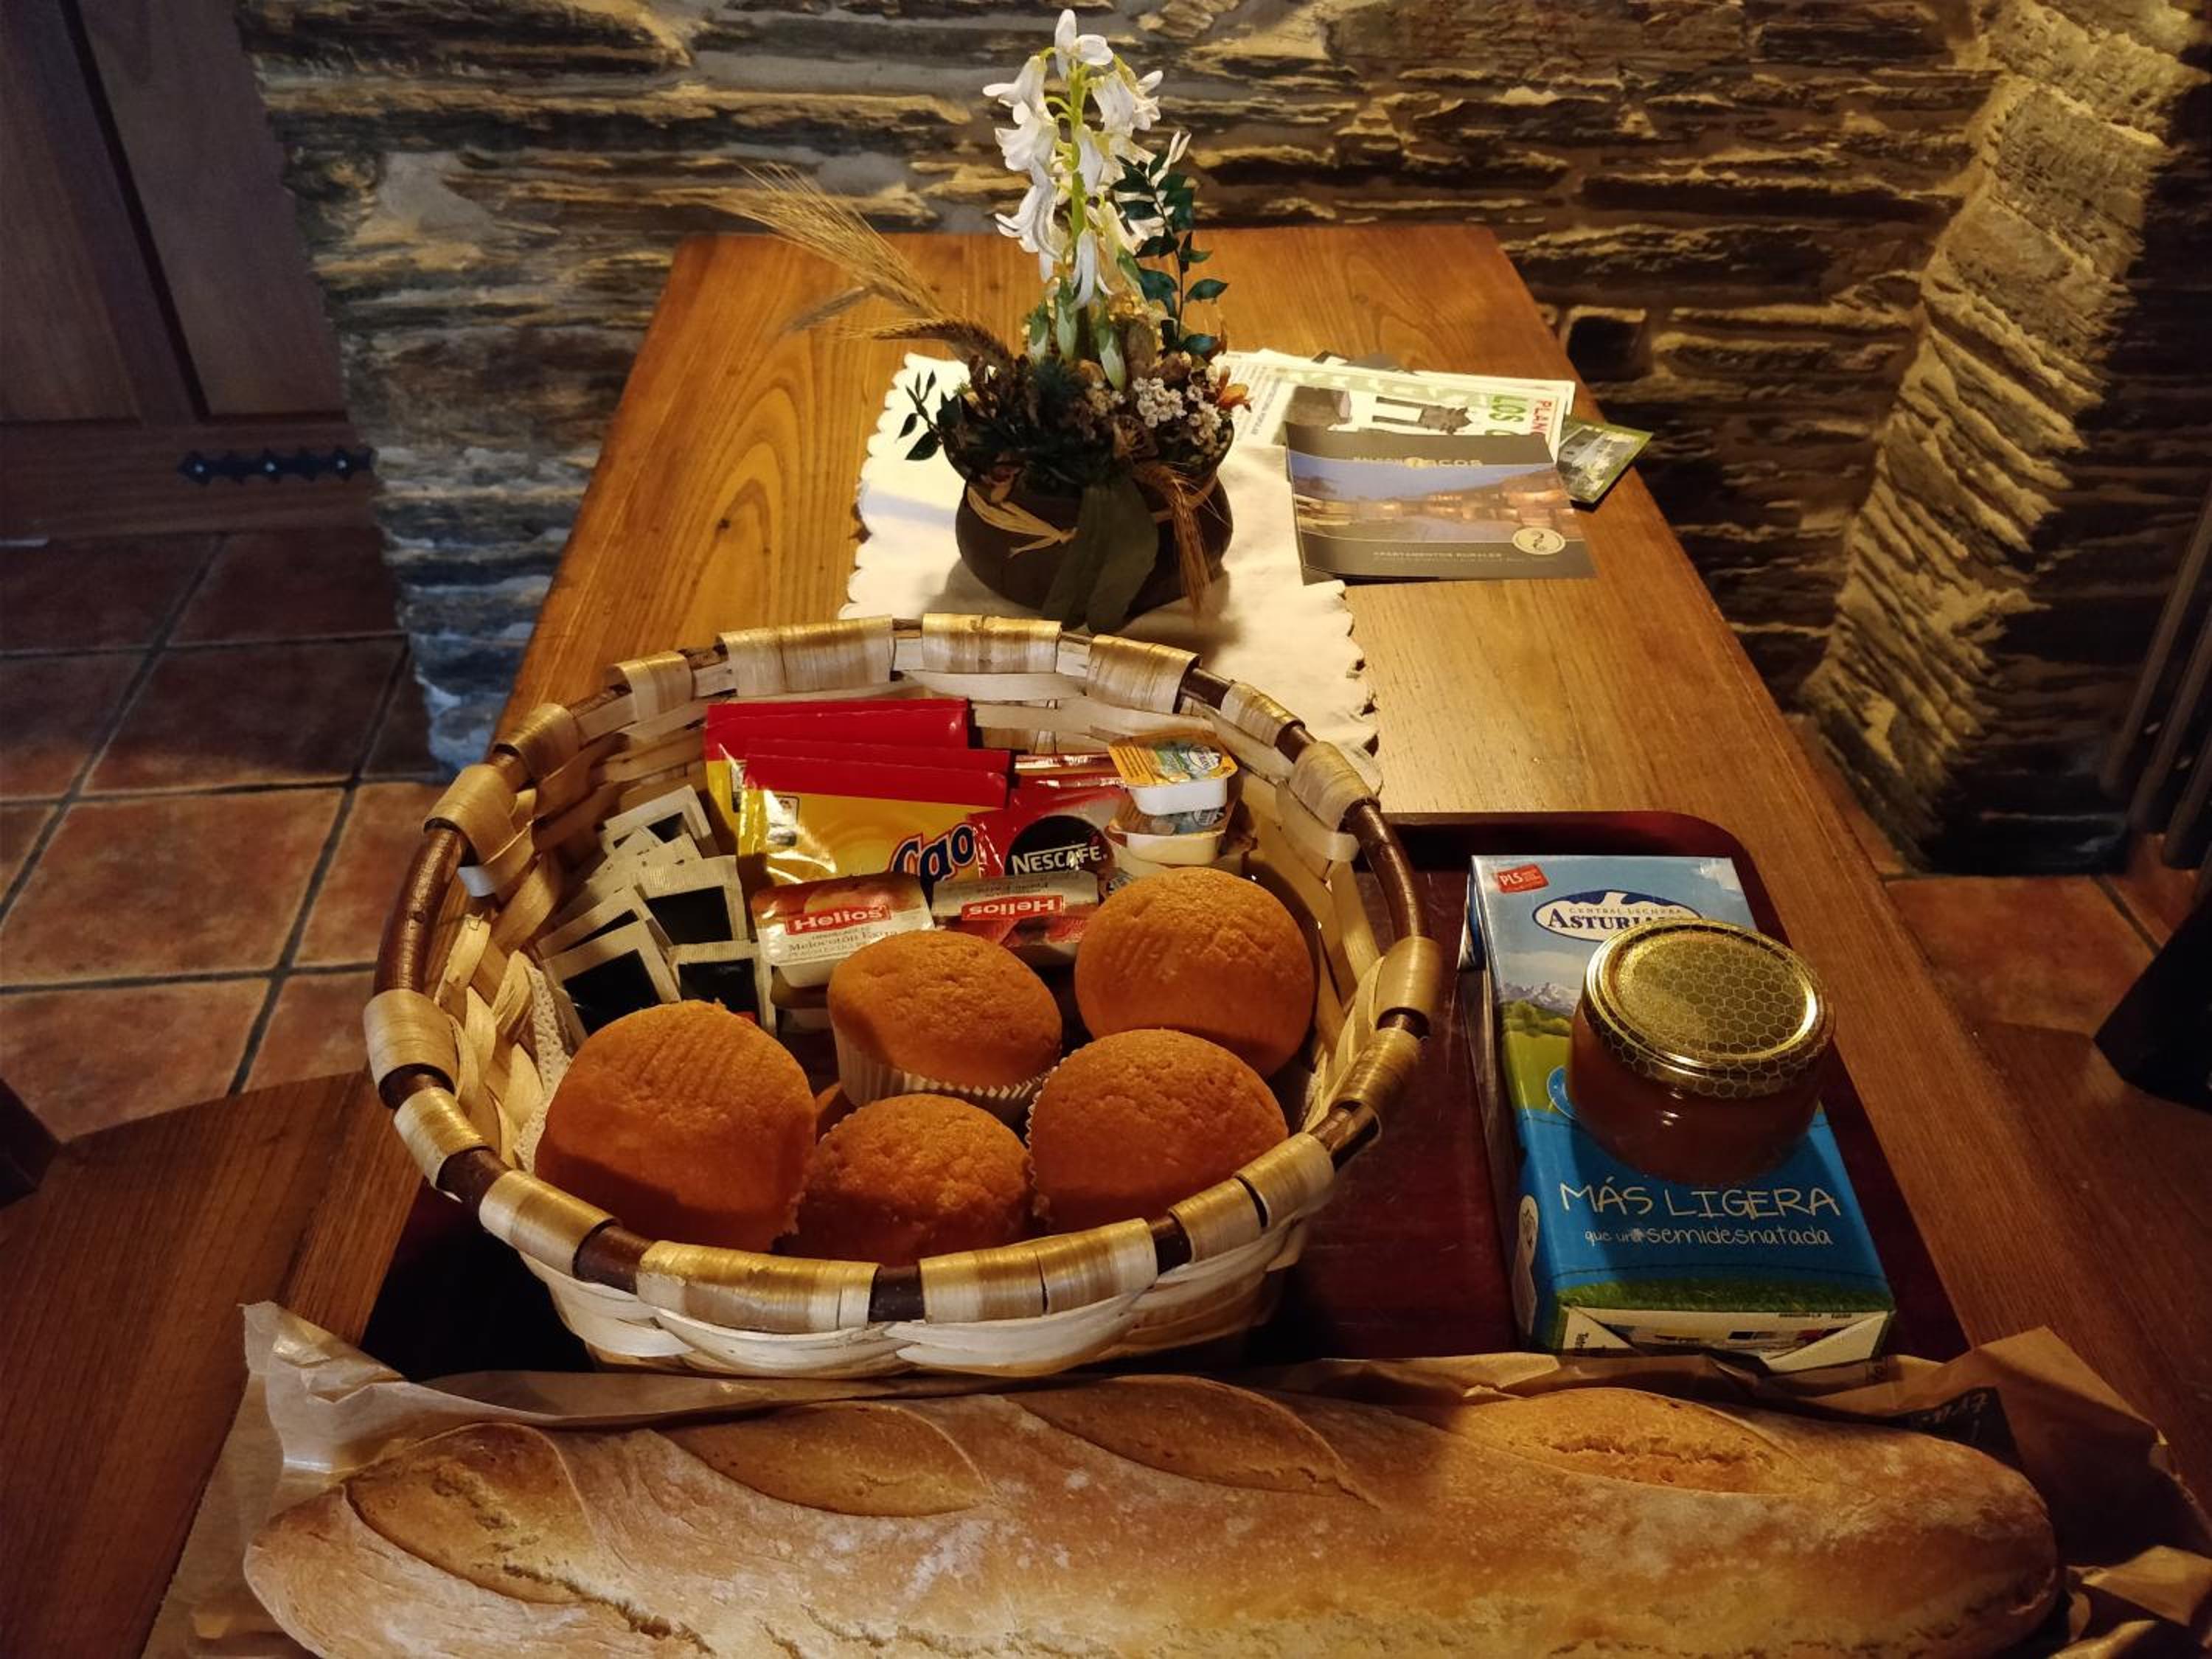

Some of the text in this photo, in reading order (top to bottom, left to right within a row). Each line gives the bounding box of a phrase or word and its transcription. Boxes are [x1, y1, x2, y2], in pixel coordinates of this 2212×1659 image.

[1488, 394, 1528, 422] LOS
[890, 824, 975, 882] Cao
[1499, 872, 1523, 885] PLS
[794, 906, 885, 931] Helios
[968, 899, 1055, 915] Helios
[1559, 1176, 1842, 1220] MÁS LIGERA
[1646, 1226, 1834, 1245] semidesnatada
